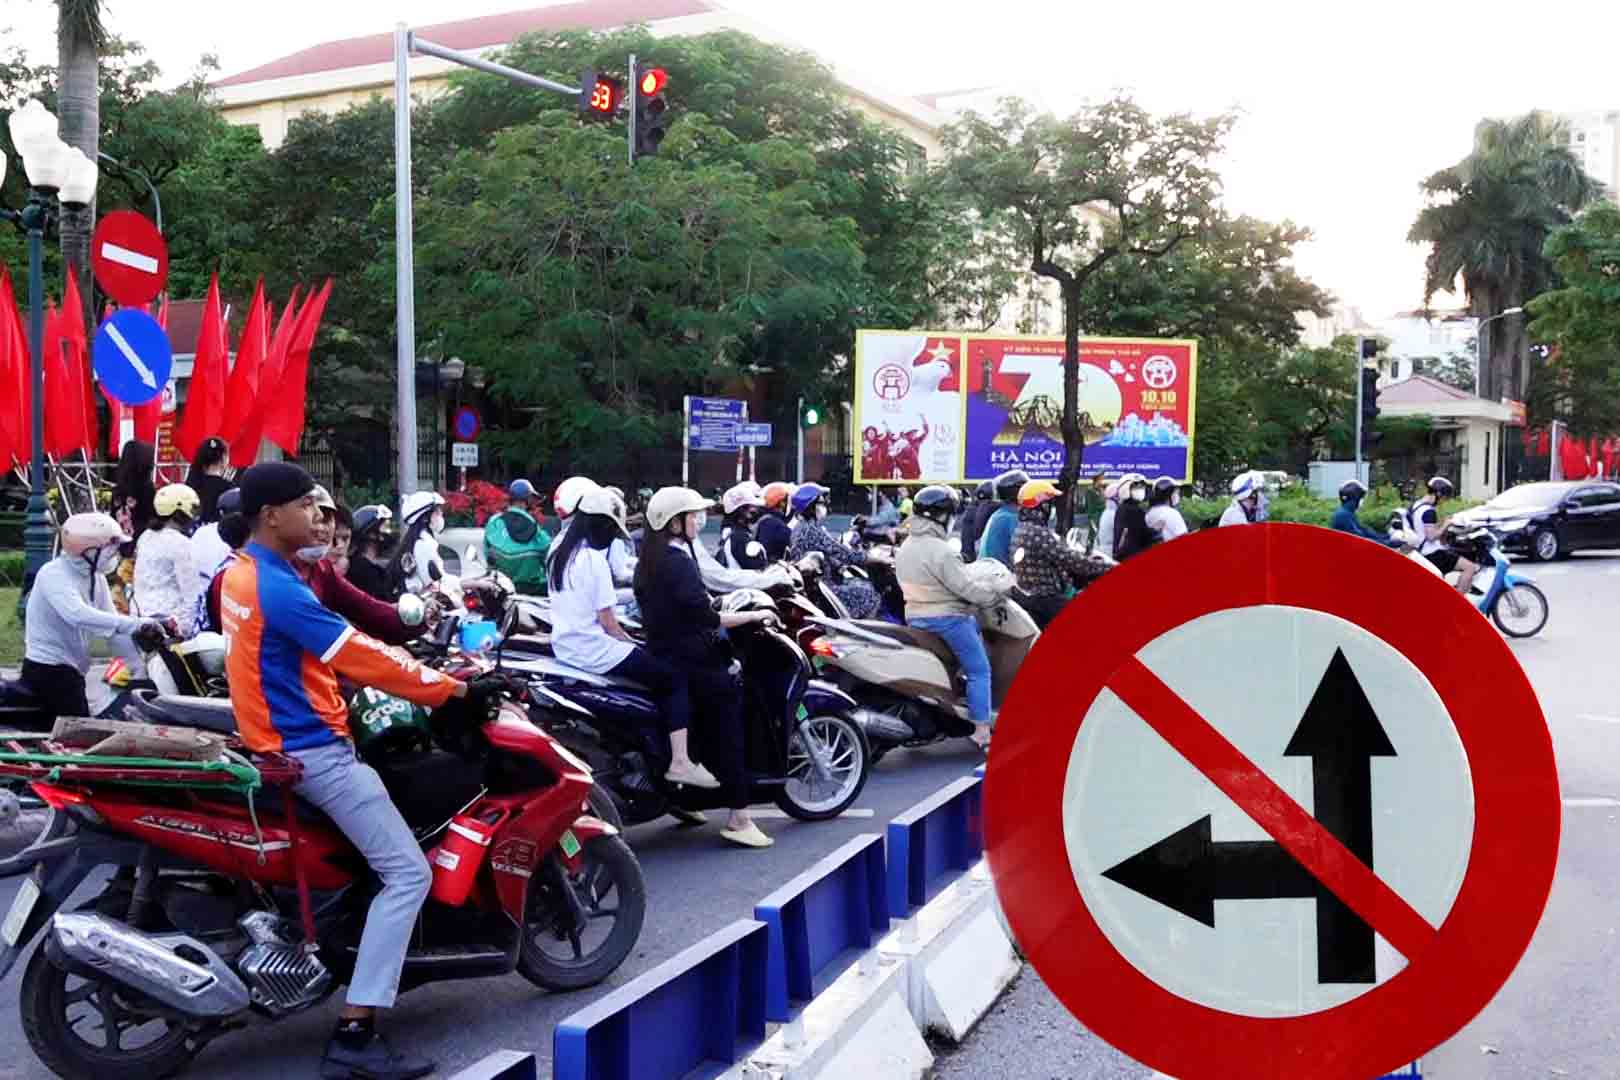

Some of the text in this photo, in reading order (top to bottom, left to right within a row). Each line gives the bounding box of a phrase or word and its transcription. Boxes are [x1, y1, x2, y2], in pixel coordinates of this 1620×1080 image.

[991, 449, 1061, 464] HÀ NỘI
[361, 699, 406, 725] Grab
